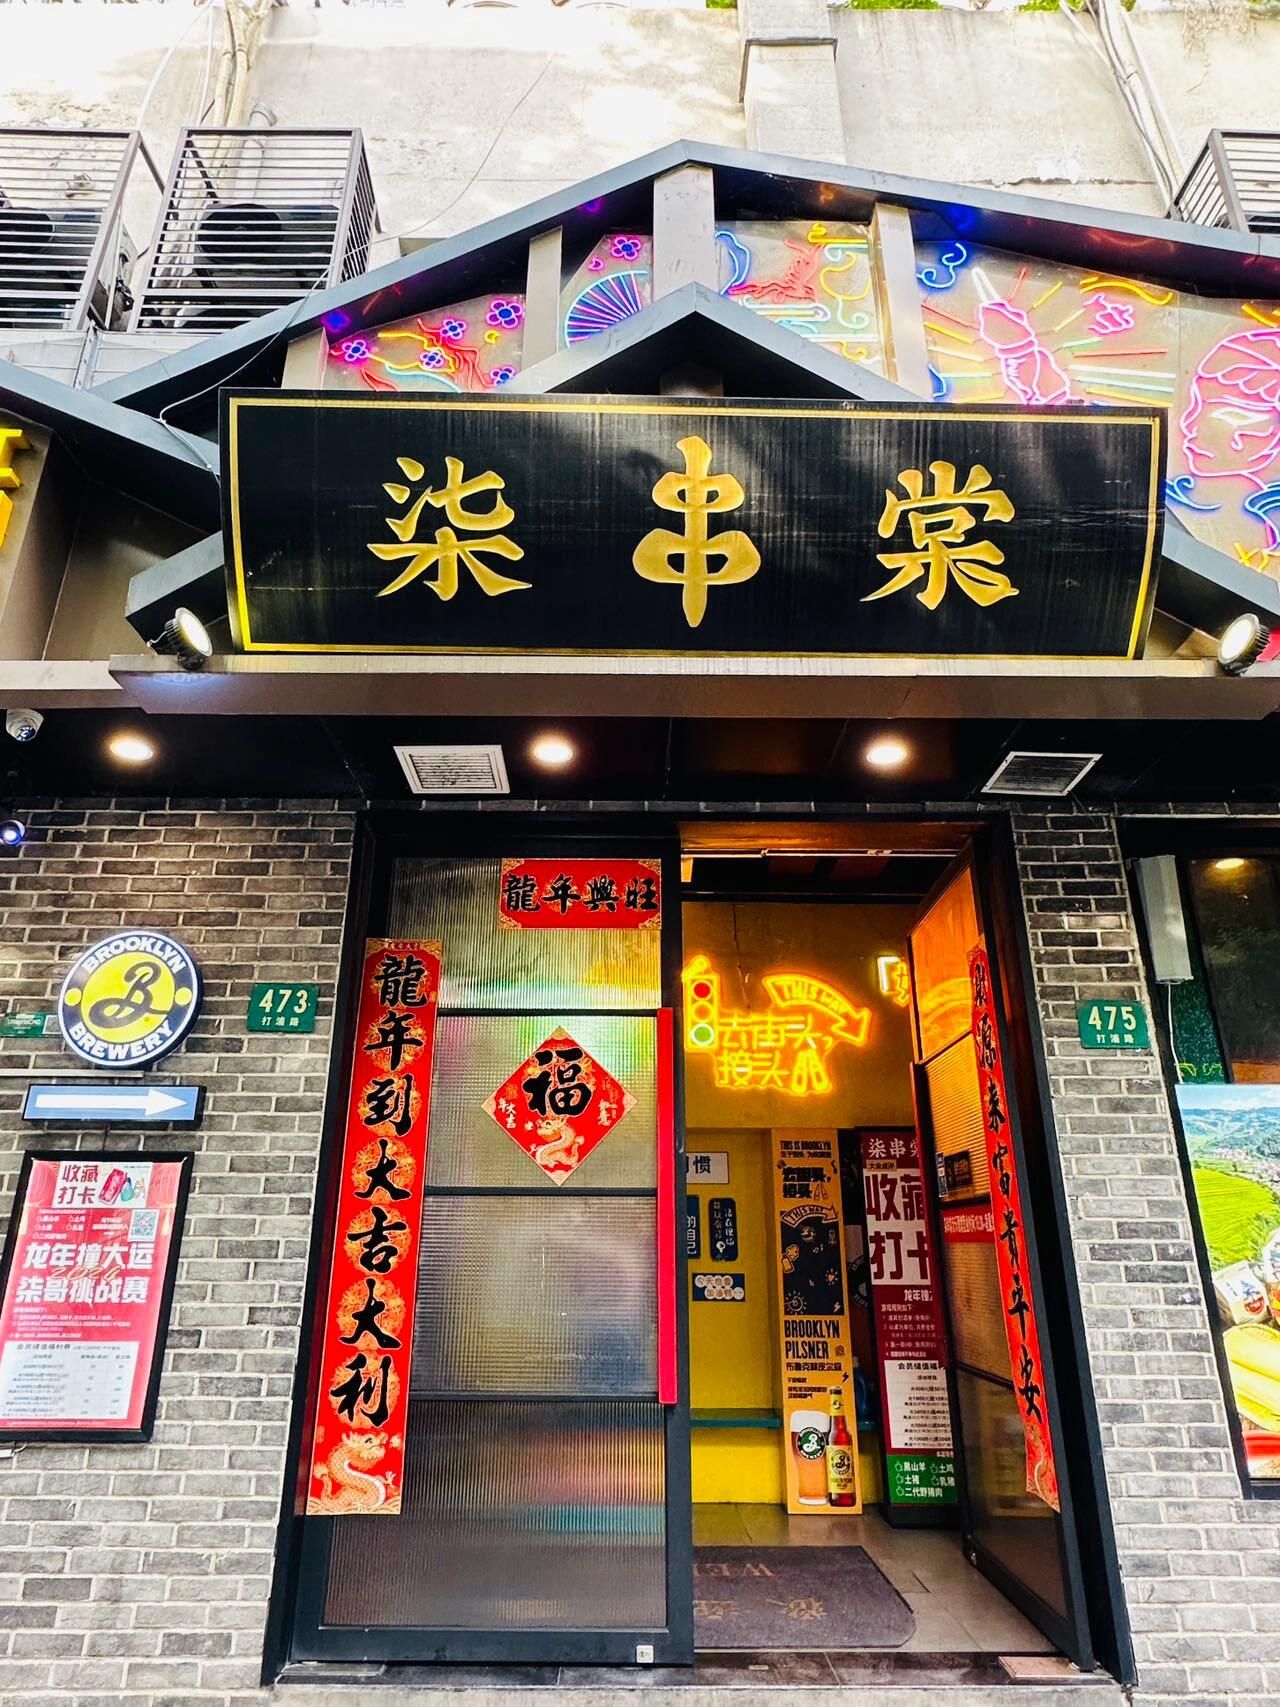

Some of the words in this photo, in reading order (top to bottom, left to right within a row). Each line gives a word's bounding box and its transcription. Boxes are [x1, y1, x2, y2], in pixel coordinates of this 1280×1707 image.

[366, 434, 1020, 629] 柒串棠
[502, 872, 661, 915] 龍年興旺
[81, 936, 187, 974] BROOKLYN
[258, 988, 309, 1014] 473
[774, 981, 819, 1001] THIS
[1088, 1005, 1137, 1031] 475
[68, 1017, 174, 1060] BREWERY
[522, 1046, 593, 1118] 福
[62, 1164, 99, 1183] 收藏
[57, 1186, 96, 1204] 打卡
[330, 953, 430, 1428] 龍年到大吉大利
[785, 1206, 808, 1221] THIS
[22, 1242, 155, 1270] 龙年撞大运
[50, 1266, 122, 1281] 2024
[15, 1276, 150, 1305] 柒哥挑战赛
[784, 1319, 841, 1339] BROOKLYN
[784, 1340, 830, 1359] PILSNER
